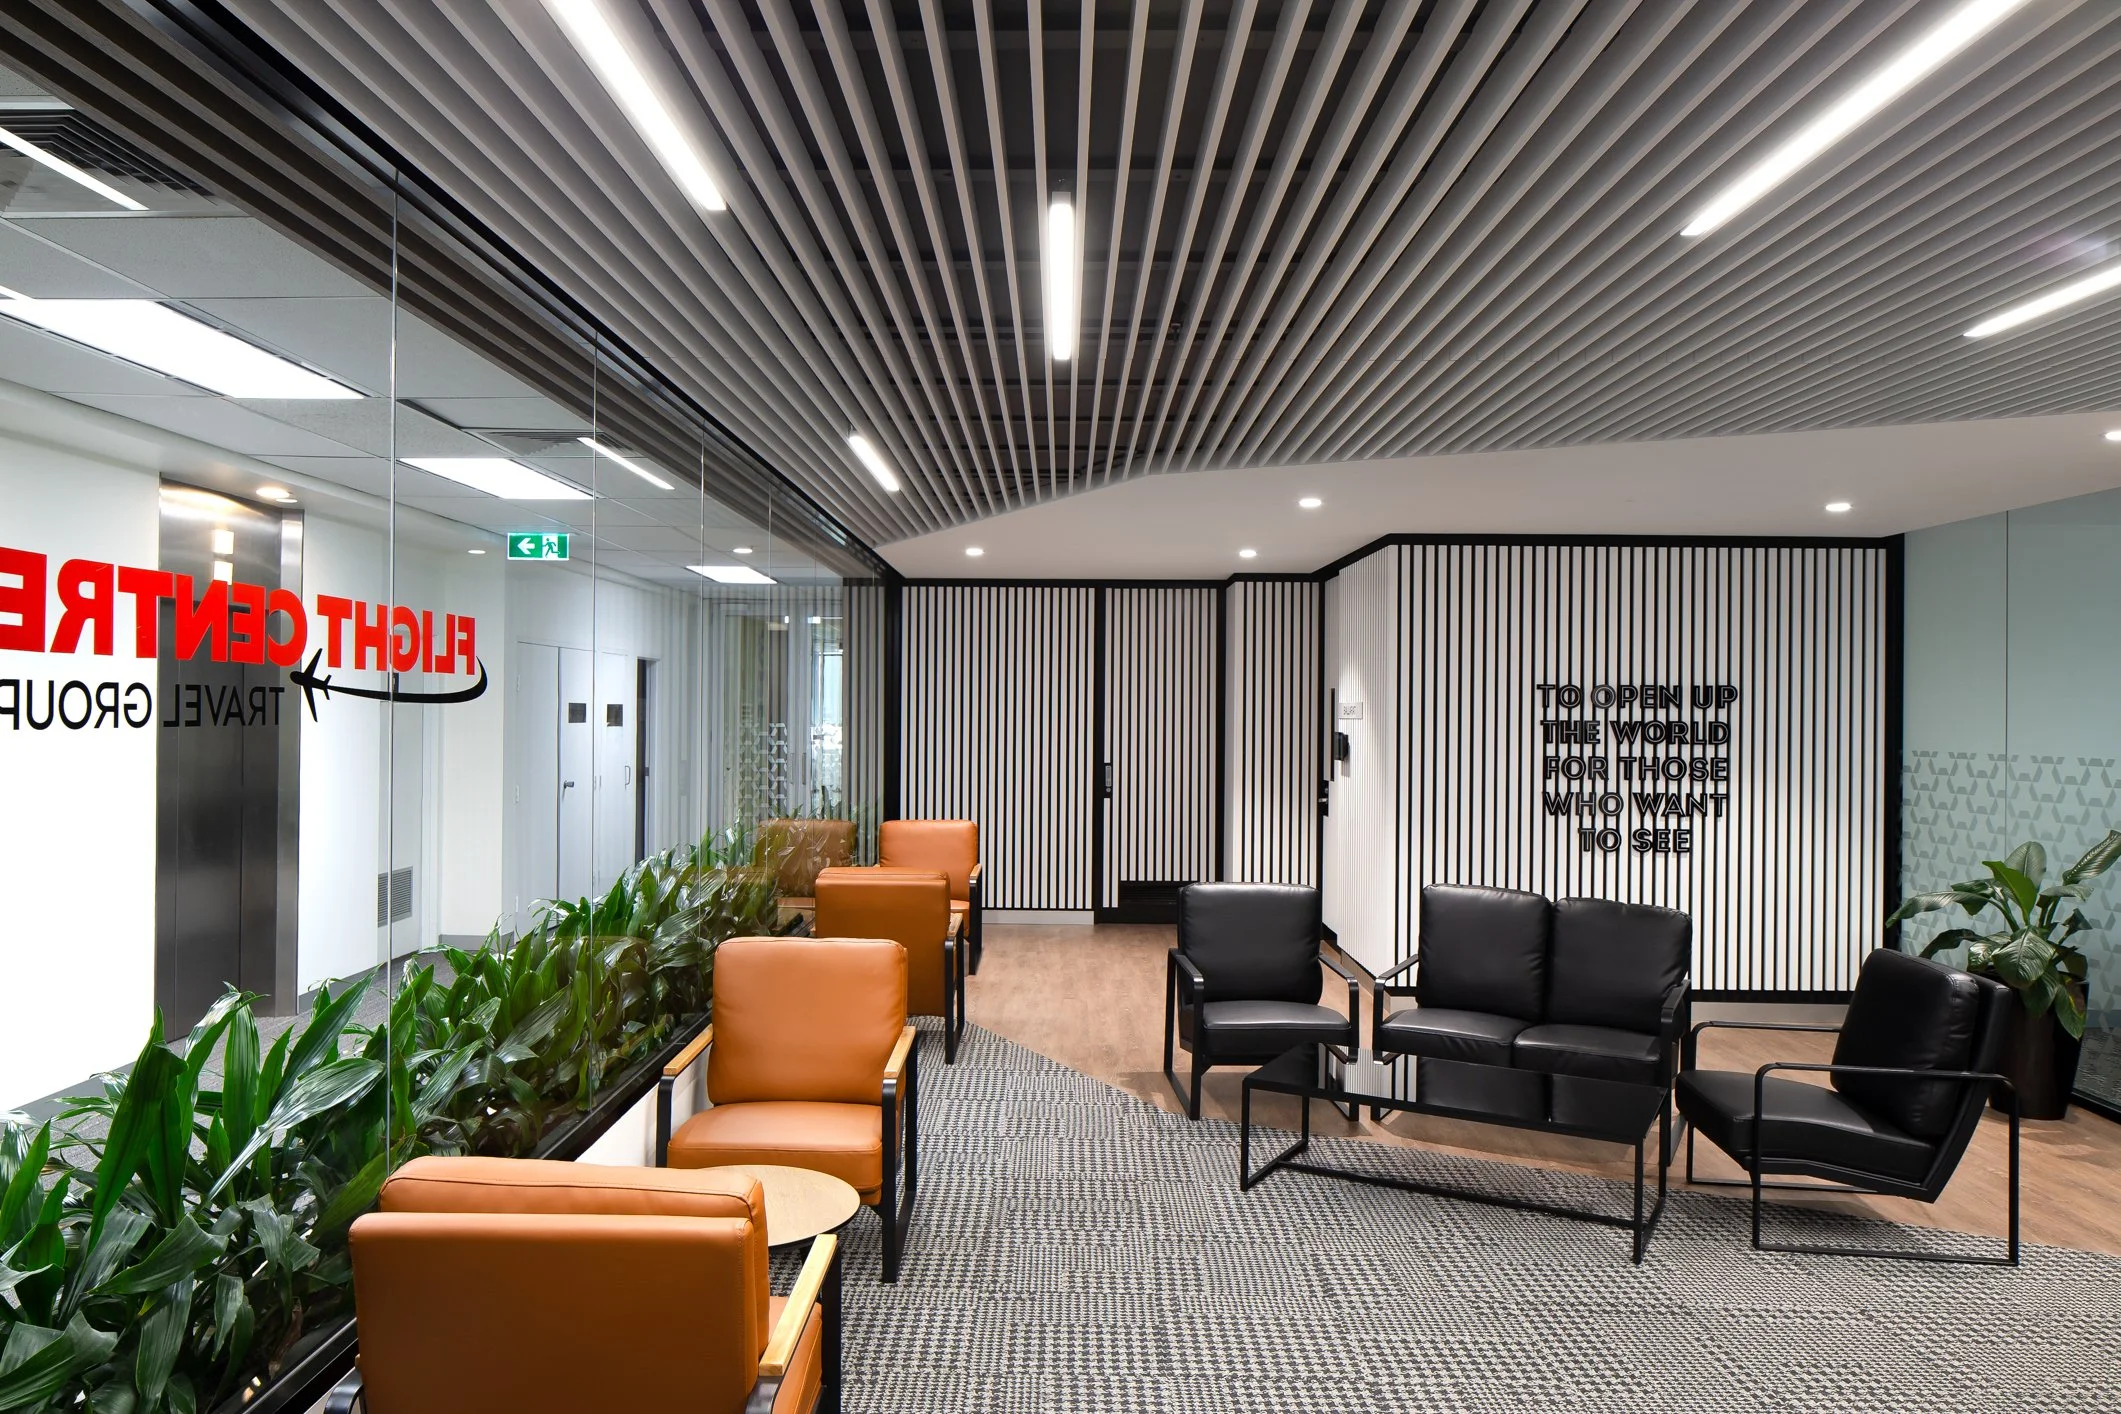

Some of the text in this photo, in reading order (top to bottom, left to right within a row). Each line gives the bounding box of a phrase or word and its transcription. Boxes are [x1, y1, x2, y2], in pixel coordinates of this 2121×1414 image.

[1537, 684, 1738, 709] TO OPEN UP
[1541, 720, 1730, 745] THE WORLD
[1545, 756, 1728, 781] FOR THOSE
[1544, 792, 1728, 817] WHO WANT
[1578, 828, 1691, 853] TO SEE
